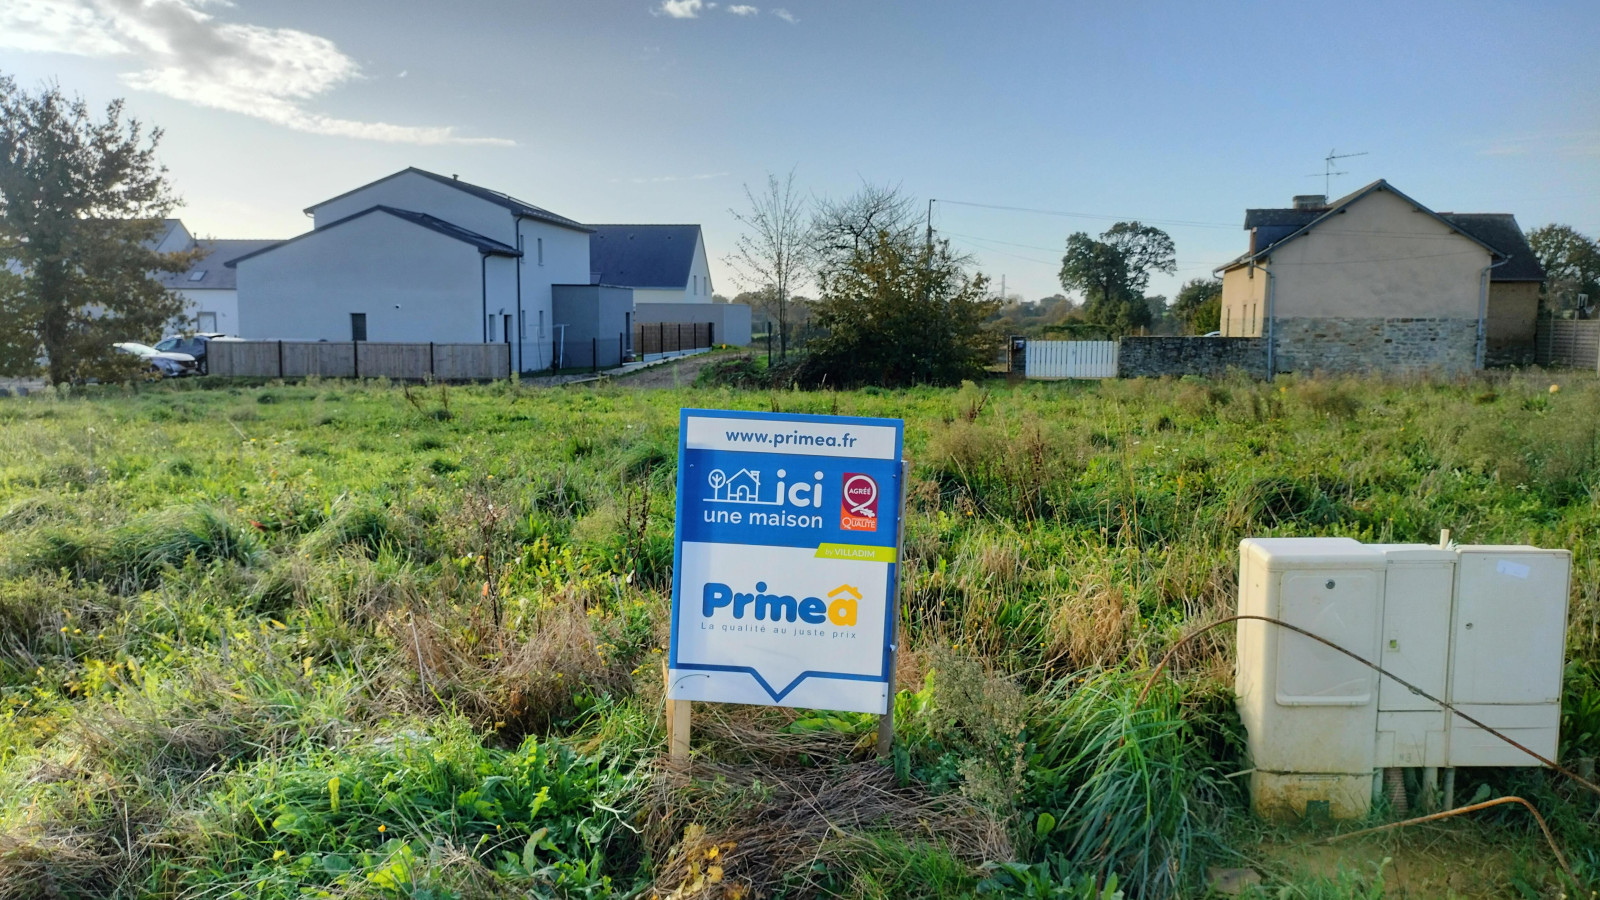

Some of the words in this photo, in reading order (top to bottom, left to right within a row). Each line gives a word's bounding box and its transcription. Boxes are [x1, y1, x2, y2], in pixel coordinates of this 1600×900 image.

[726, 430, 857, 448] www.primea.fr
[776, 468, 824, 508] ici
[703, 509, 742, 524] une
[749, 510, 823, 528] maison
[834, 548, 875, 558] VILLADIM
[701, 622, 714, 630] La
[721, 623, 766, 633] qualité
[793, 628, 825, 637] juste
[832, 631, 856, 639] prix
